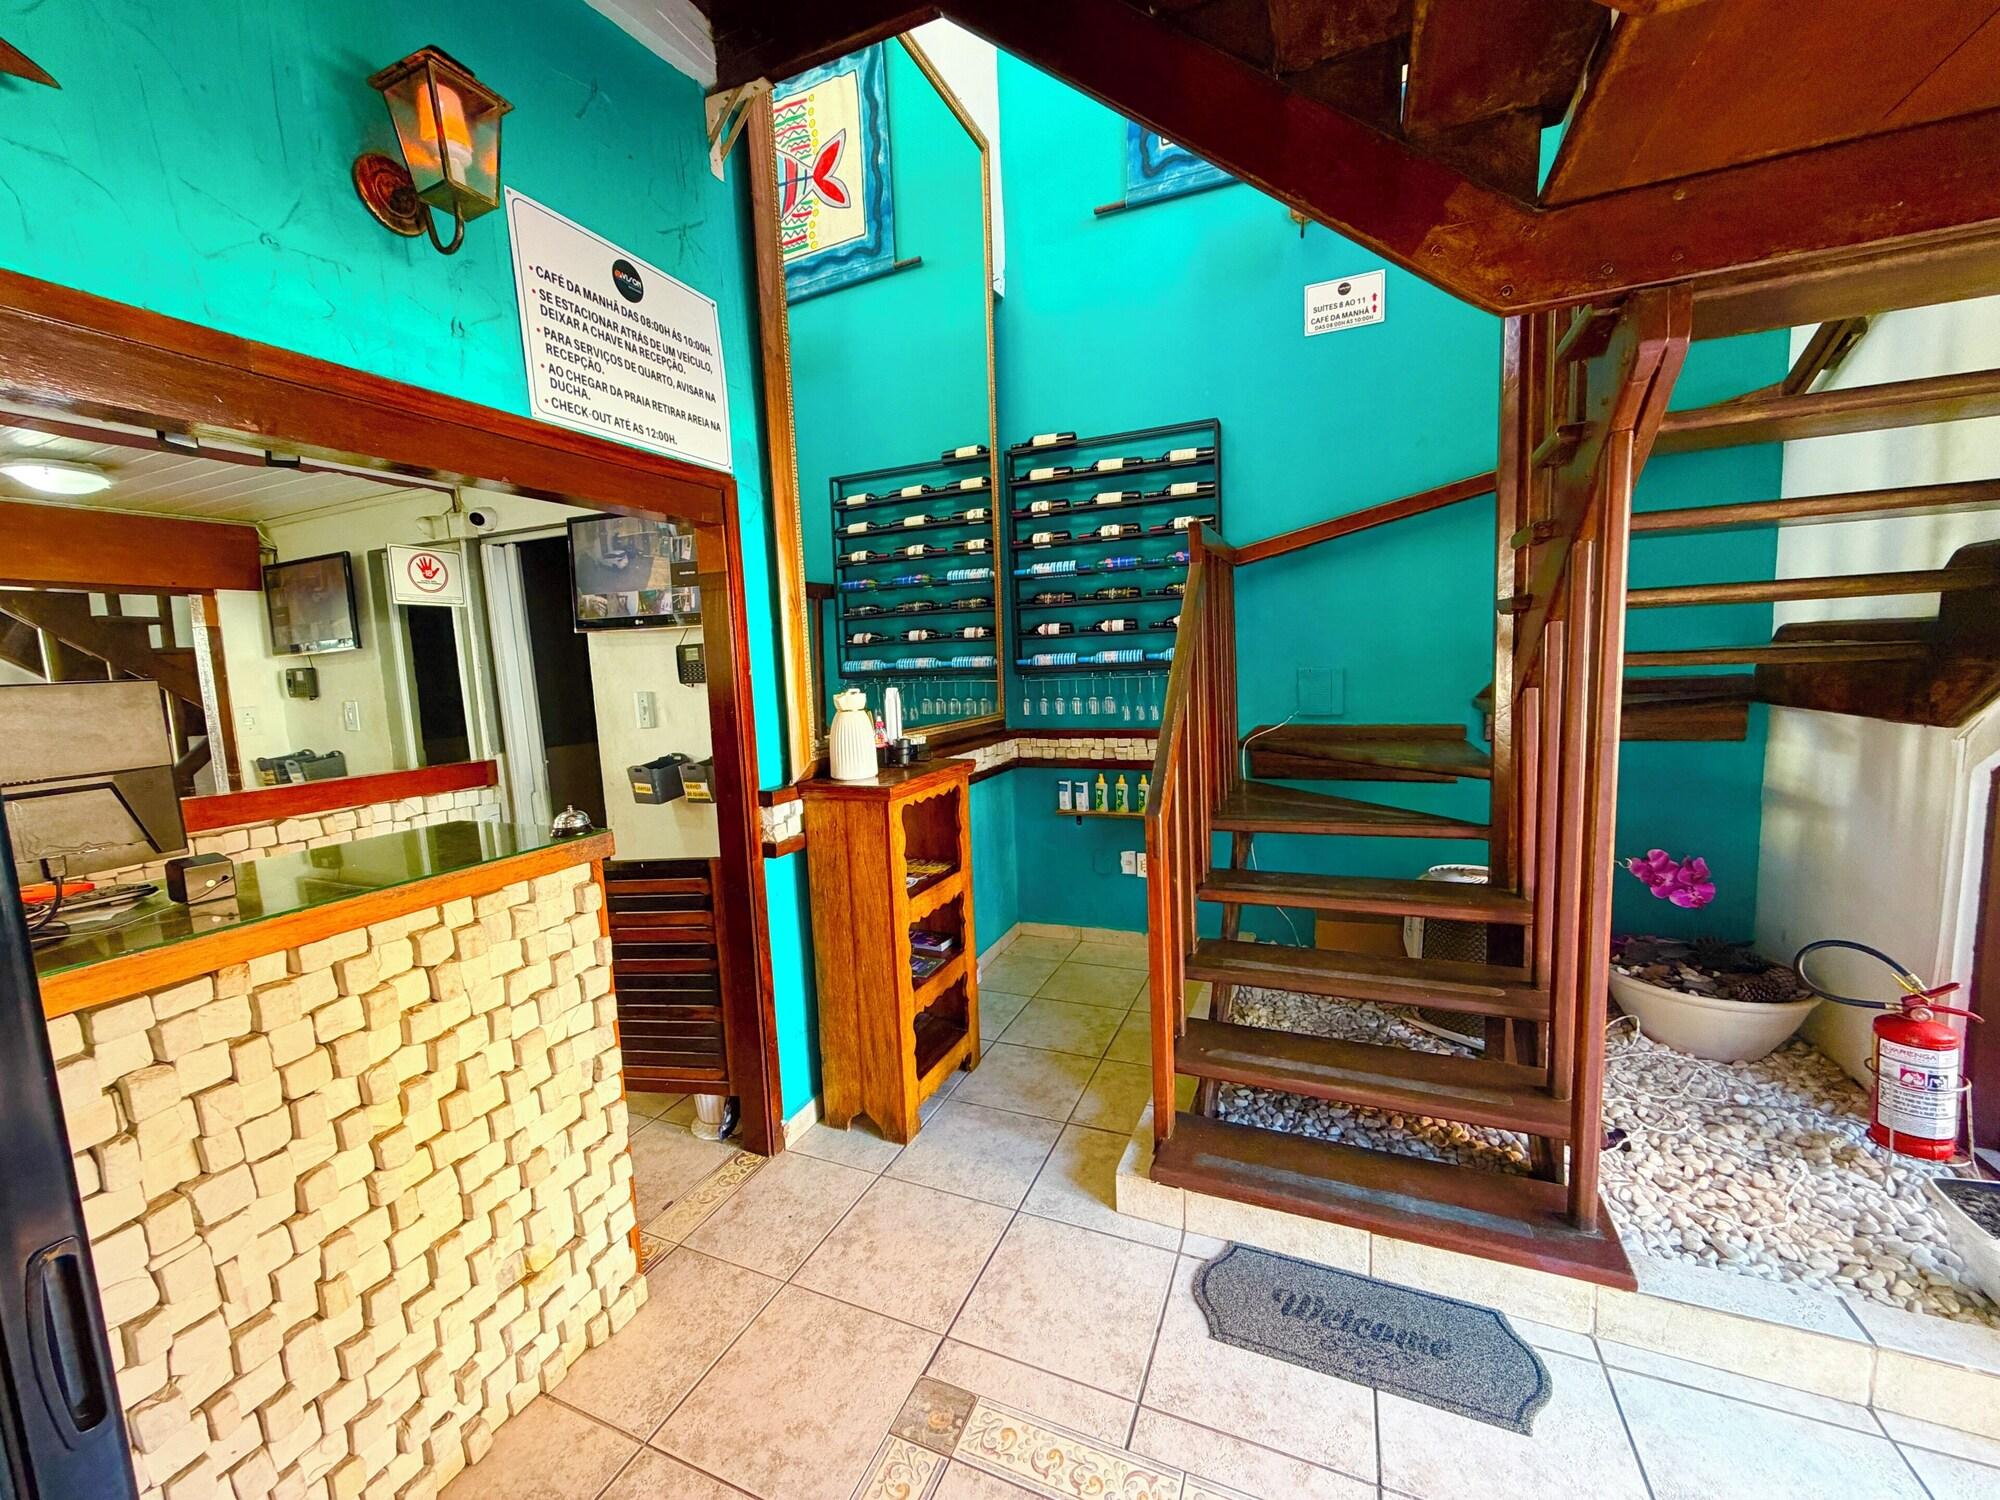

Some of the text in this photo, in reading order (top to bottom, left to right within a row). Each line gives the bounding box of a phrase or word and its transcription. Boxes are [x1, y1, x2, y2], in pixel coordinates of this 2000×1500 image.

[535, 265, 565, 289] CAFÉ
[566, 279, 582, 296] DA
[582, 287, 620, 314] MANHÃ
[620, 305, 639, 323] DAS
[640, 314, 671, 338] 08:00H
[683, 335, 713, 357] 10:00H.
[538, 288, 713, 375] SE ESTACIONAR ATRÁS DE UM VEÍCULO,
[539, 303, 686, 375] DEIXAR A CHAVE NA RECEPÇÃO.
[1313, 302, 1338, 314] SUÍTES
[1344, 298, 1356, 307] AO
[1330, 314, 1341, 322] DA
[1341, 306, 1370, 319] MANHÃ
[543, 326, 717, 404] PARA SERVIÇOS DE QUARTO, AVISAR NA
[545, 342, 605, 375] RECEPÇÃO.
[549, 377, 591, 401] DUCHA.
[548, 363, 722, 433] AO CHEGAR DA PRAIA RETIRAR AREIA NA
[551, 396, 678, 446] CHECK-OUT ATÉ AS 12:00H.
[1272, 1287, 1451, 1360] Welcome
